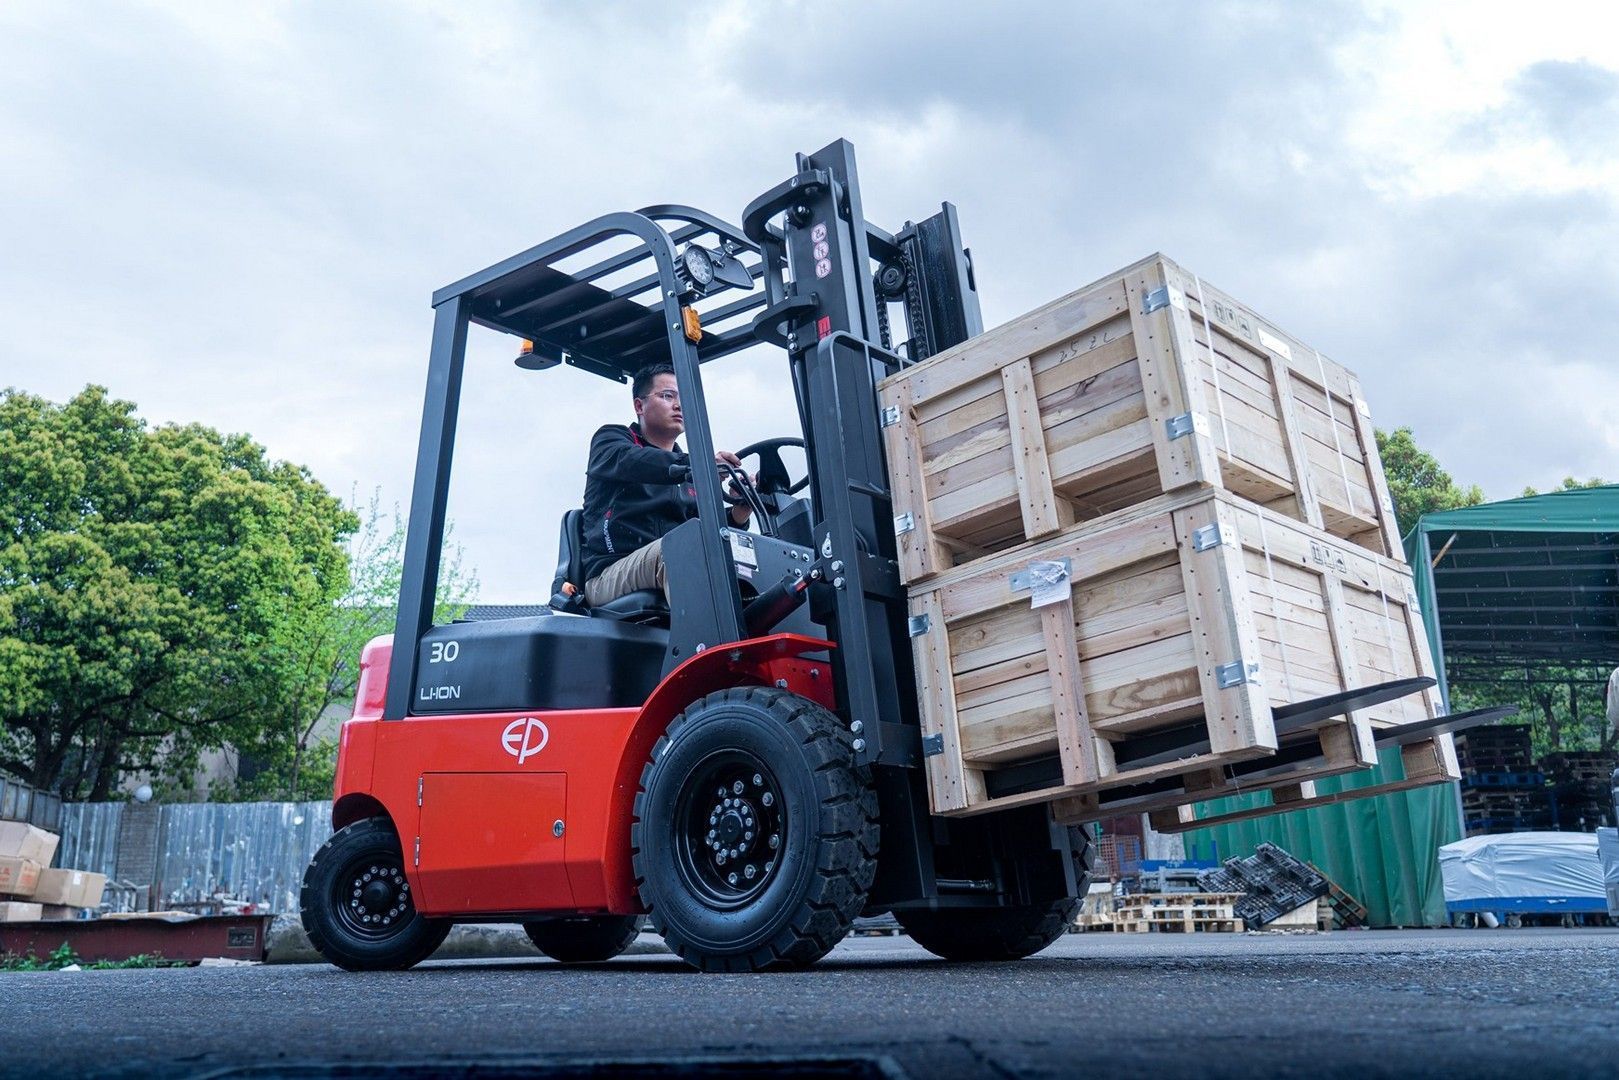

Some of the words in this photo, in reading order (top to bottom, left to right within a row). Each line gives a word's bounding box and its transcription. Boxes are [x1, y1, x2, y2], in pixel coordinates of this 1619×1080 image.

[429, 640, 460, 664] 30
[420, 685, 461, 700] LI-ION
[501, 717, 549, 765] EP
